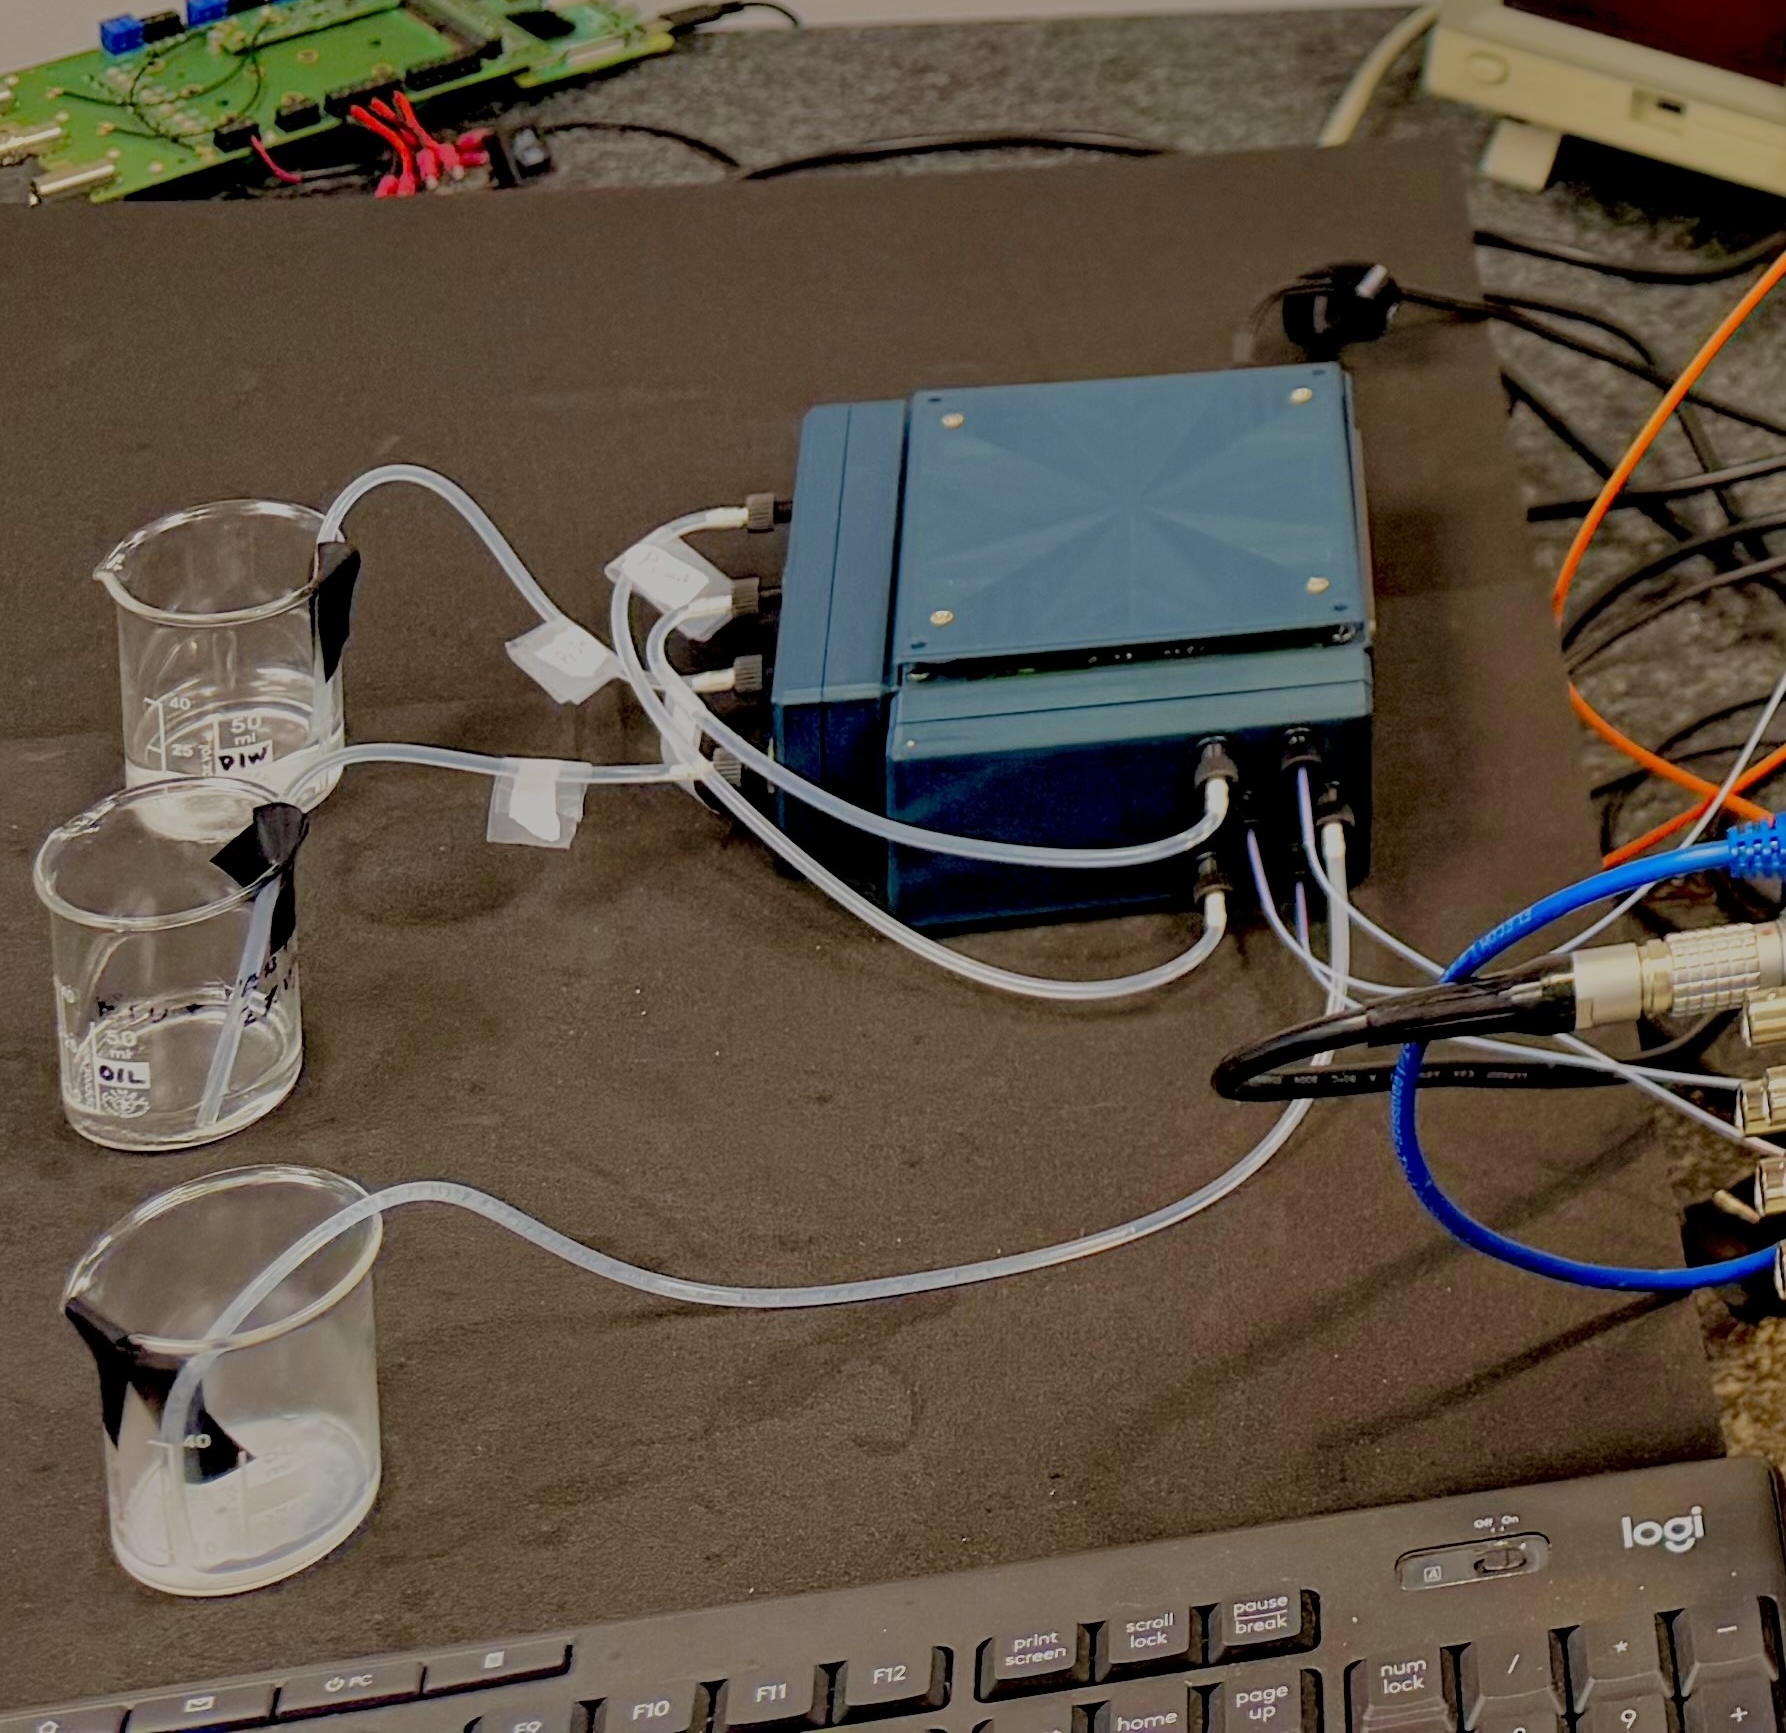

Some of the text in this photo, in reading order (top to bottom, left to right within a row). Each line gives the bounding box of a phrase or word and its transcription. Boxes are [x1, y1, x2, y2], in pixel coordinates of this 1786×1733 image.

[168, 697, 192, 711] 40
[231, 717, 263, 734] 50
[171, 743, 195, 758] 25
[234, 734, 258, 747] ml
[219, 746, 269, 771] DIW
[105, 1030, 137, 1048] 50
[99, 1065, 147, 1085] OIL
[183, 1433, 212, 1449] 40
[1473, 1514, 1521, 1530] Off On
[1621, 1505, 1706, 1553] logi
[1233, 1594, 1288, 1617] pause
[1125, 1613, 1174, 1633] scroll
[1235, 1615, 1288, 1635] break
[1013, 1631, 1059, 1652] print
[1130, 1632, 1168, 1650] lock
[1005, 1646, 1067, 1667] screen
[873, 1665, 907, 1684] F12
[1380, 1659, 1428, 1678] num
[348, 1674, 373, 1688] PC
[1383, 1675, 1425, 1695] lock
[756, 1682, 788, 1703] F11
[1235, 1684, 1289, 1708] page
[632, 1700, 671, 1721] F10
[1248, 1703, 1277, 1723] up
[1619, 1708, 1638, 1729] 9
[1116, 1710, 1178, 1733] home
